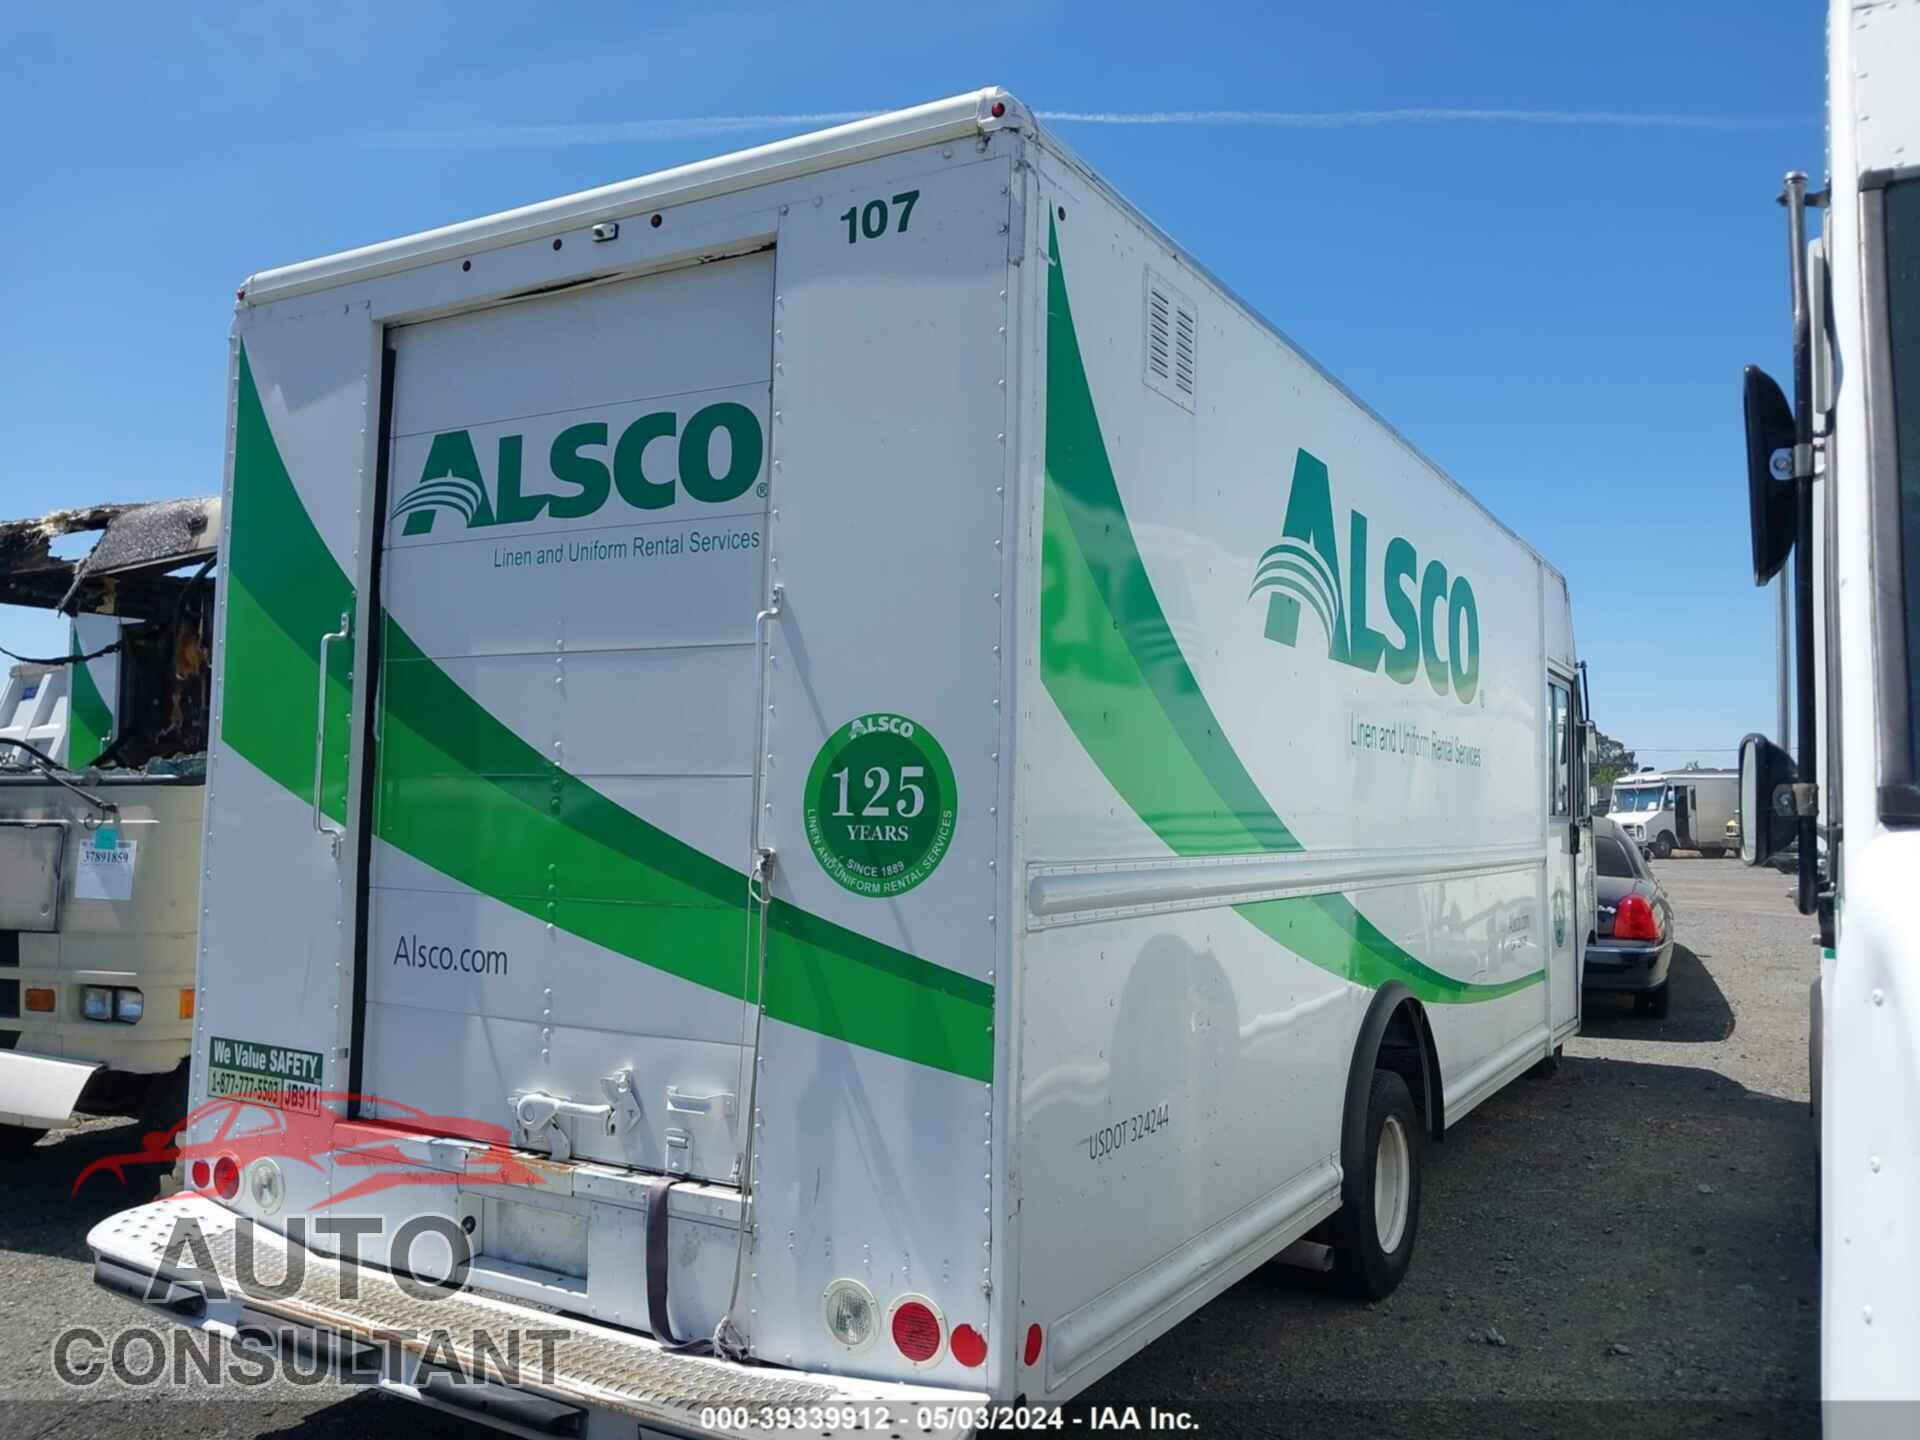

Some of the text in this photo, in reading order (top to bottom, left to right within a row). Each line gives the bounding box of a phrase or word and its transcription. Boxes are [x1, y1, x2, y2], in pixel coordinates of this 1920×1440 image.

[840, 189, 920, 244] 107
[391, 401, 764, 536] ALSCO
[494, 529, 761, 568] Linen and Uniform Rental Services
[1247, 446, 1480, 705] ALSCO
[848, 716, 915, 740] ALSCO
[1351, 711, 1480, 768] Linen and Uniform Rental Services
[831, 766, 925, 818] 125
[807, 808, 953, 893] LINEN AND UNIFORM RENTAL SERVICES
[846, 824, 909, 842] YEARS
[846, 857, 879, 878] SINCE
[393, 935, 508, 976] Alsco.com
[213, 1040, 318, 1079] We Value SAFETY
[211, 1070, 319, 1111] 1-877-777-5503 JB911
[1089, 1103, 1169, 1160] USDOT 324244
